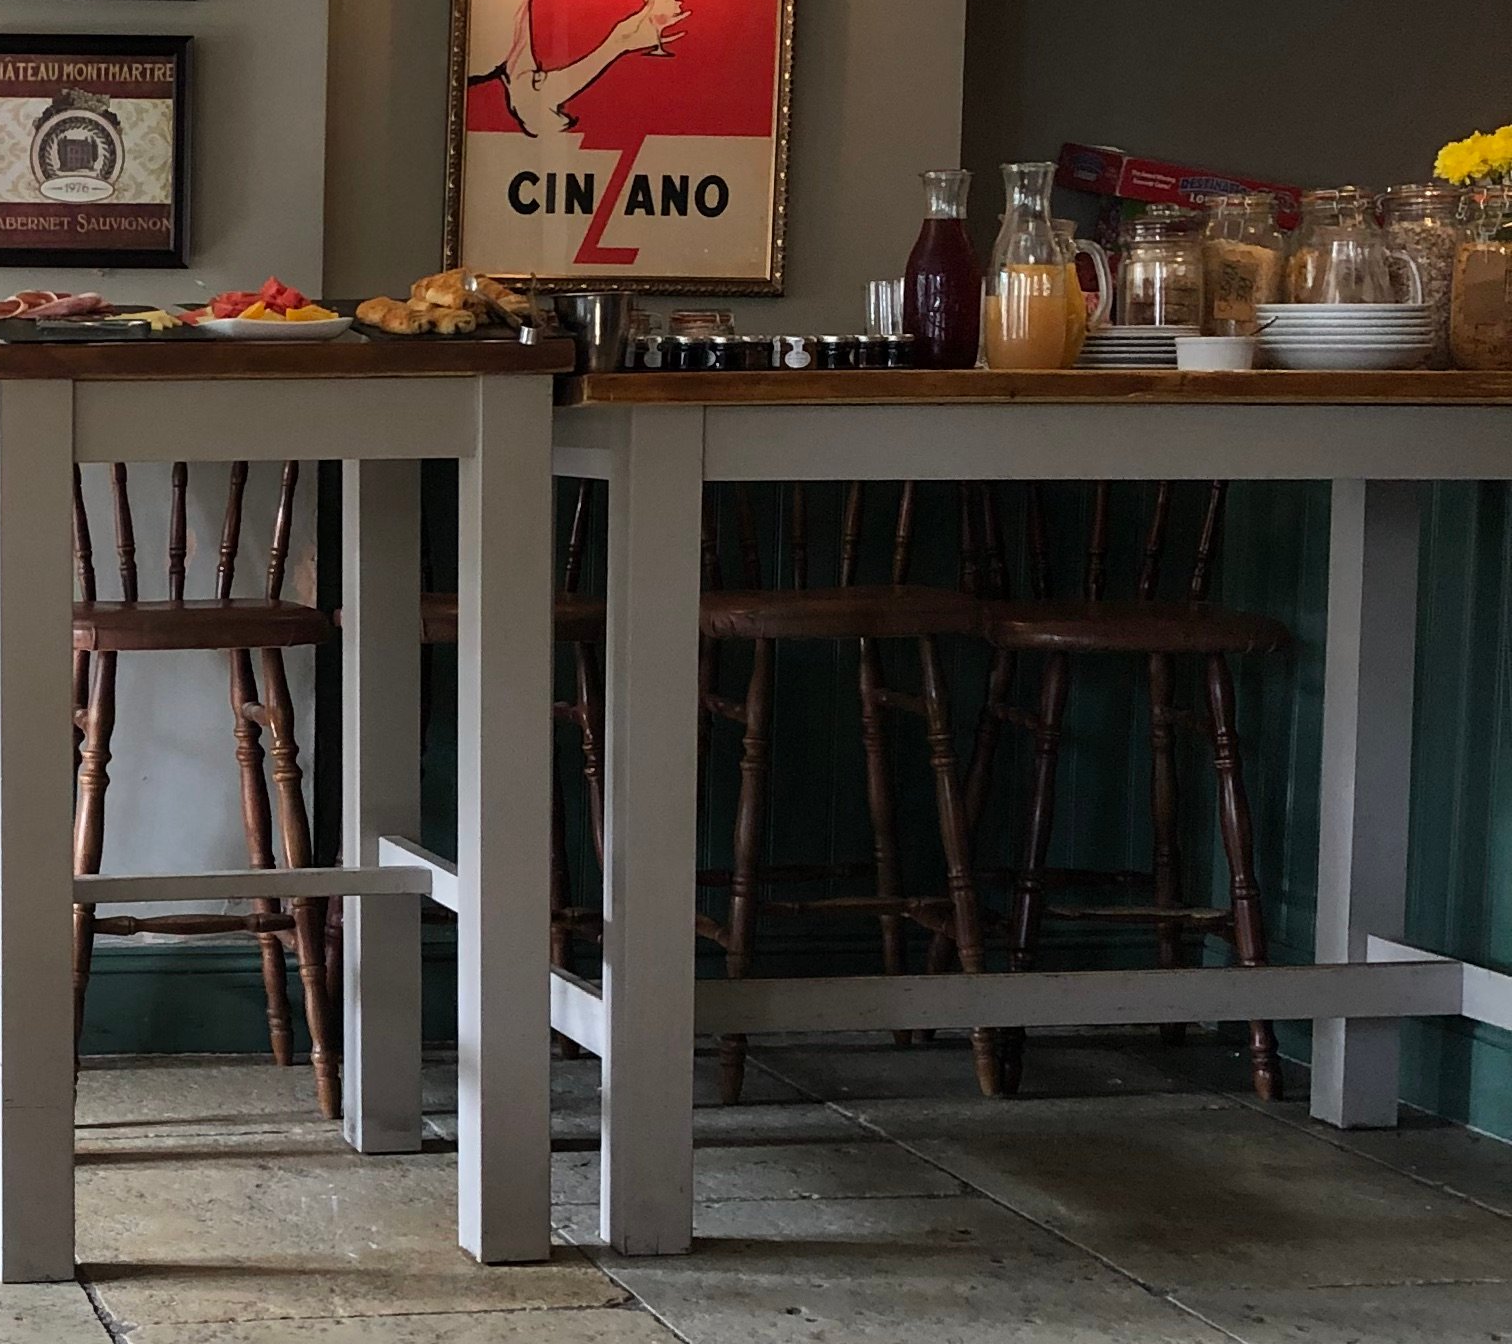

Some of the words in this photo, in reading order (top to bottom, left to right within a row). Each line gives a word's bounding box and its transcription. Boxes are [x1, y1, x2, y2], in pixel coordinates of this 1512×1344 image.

[63, 63, 174, 82] MONTMARTRE
[64, 182, 89, 194] 1976
[507, 134, 730, 264] CINZANO
